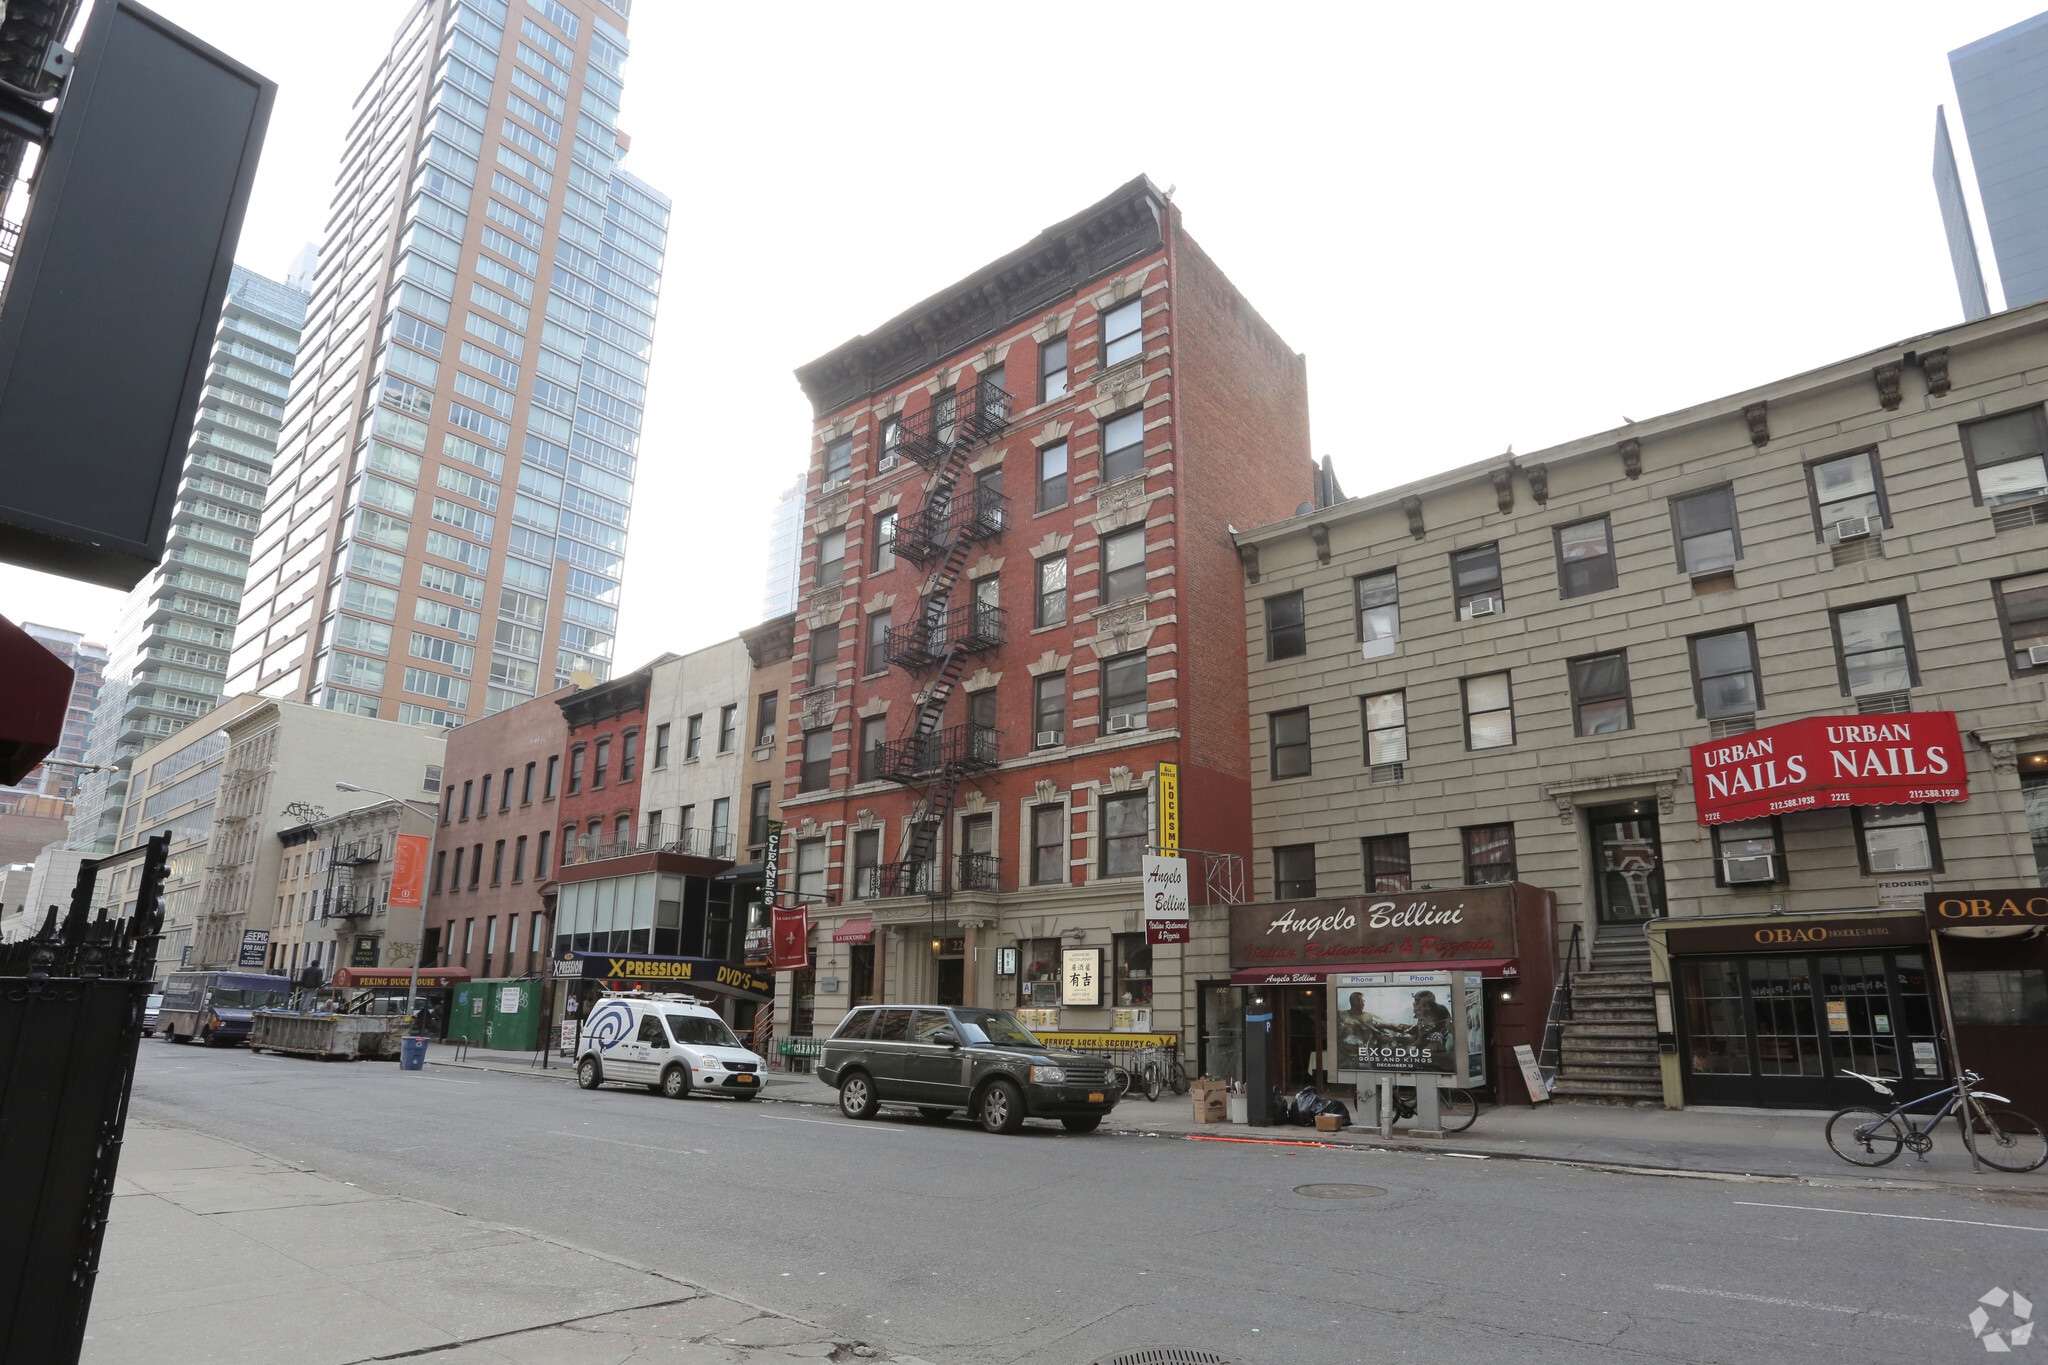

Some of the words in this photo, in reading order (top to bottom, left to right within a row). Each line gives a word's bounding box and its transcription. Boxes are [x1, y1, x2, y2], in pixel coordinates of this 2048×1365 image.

[1826, 723, 1911, 744] URBAN
[1703, 737, 1774, 768] URBAN
[1829, 746, 1949, 778] NAILS
[1705, 755, 1807, 799] NAILS
[1831, 792, 1851, 801] 222E
[1909, 788, 1960, 799] 212.588.1938
[1704, 812, 1721, 822] 222E
[1770, 796, 1816, 810] 212.588.1938
[764, 834, 779, 905] CLEANERS
[1147, 864, 1182, 889] Angelo
[1878, 880, 1930, 889] FEDDERS
[1154, 892, 1187, 912] Bellini
[1938, 897, 2048, 918] OBAO
[1148, 920, 1164, 930] Italian
[1266, 907, 1358, 941] Angelo
[1368, 901, 1465, 929] Bellini
[252, 931, 269, 941] EPIC
[1754, 927, 1827, 944] OBAO
[1244, 943, 1297, 961] Italian
[1303, 940, 1395, 960] Restaurant
[1400, 936, 1414, 955] &
[1419, 936, 1495, 958] Pizzeria
[552, 959, 584, 977] XPRESSION
[606, 958, 692, 978] XPRESSION
[716, 965, 752, 990] DVD'S
[360, 977, 388, 986] PEKING
[390, 978, 410, 986] DUCK
[416, 978, 436, 986] OUSE
[1024, 983, 1030, 991] A
[1069, 972, 1093, 987] 有吉
[1265, 973, 1291, 985] Angelo
[1292, 973, 1317, 983] Bellini
[1266, 1021, 1271, 1033] P
[1044, 1038, 1075, 1047] SERVICE
[1077, 1038, 1097, 1046] LOCK
[1105, 1038, 1144, 1048] SECURITY
[1358, 1047, 1432, 1058] EXODUS
